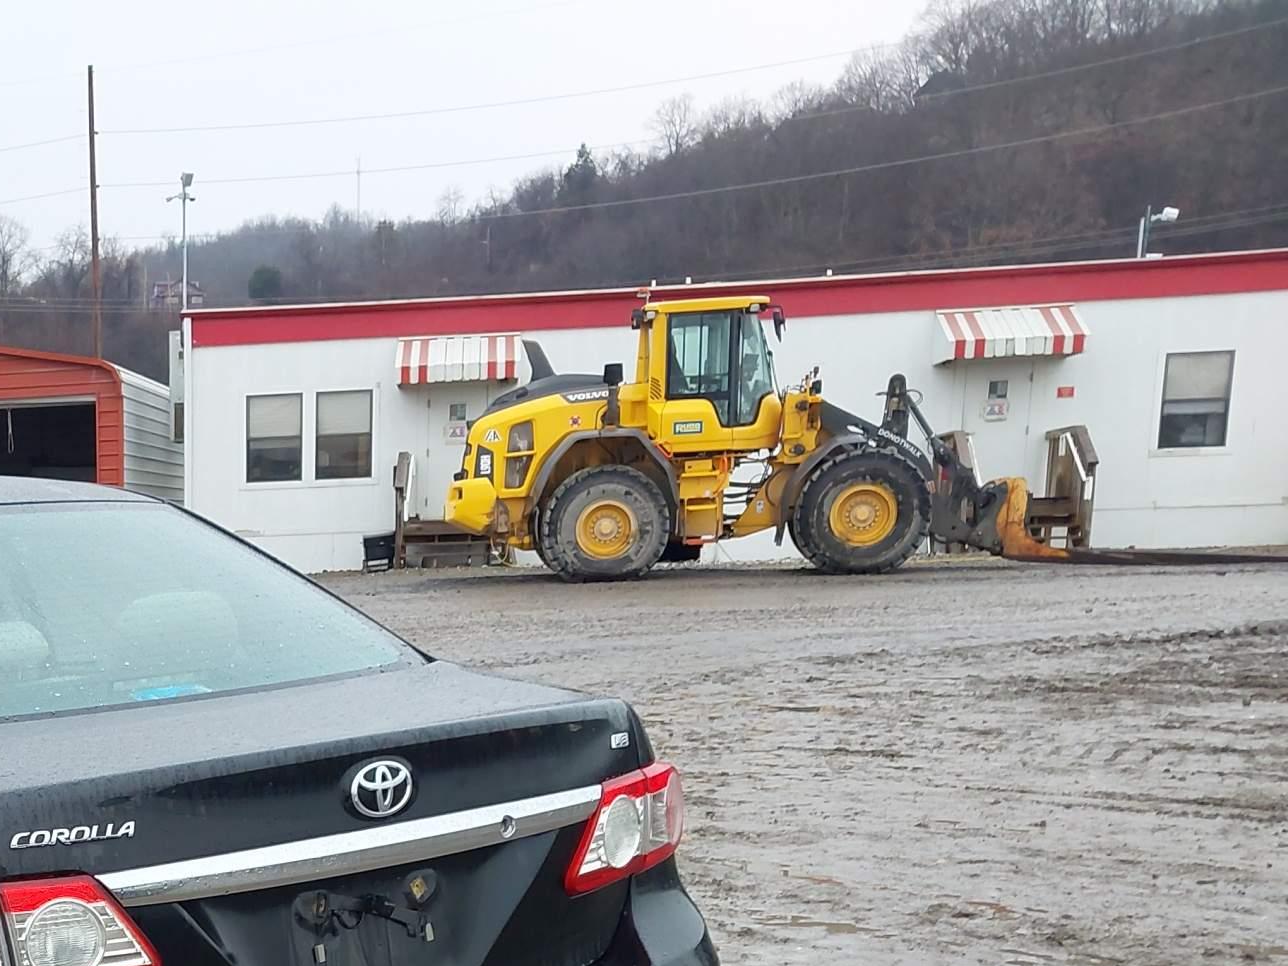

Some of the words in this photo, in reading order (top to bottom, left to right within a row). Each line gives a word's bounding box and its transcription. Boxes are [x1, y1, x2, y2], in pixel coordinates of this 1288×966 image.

[567, 390, 609, 402] VOLVO
[610, 731, 630, 749] LE
[9, 820, 136, 849] COROLLA
